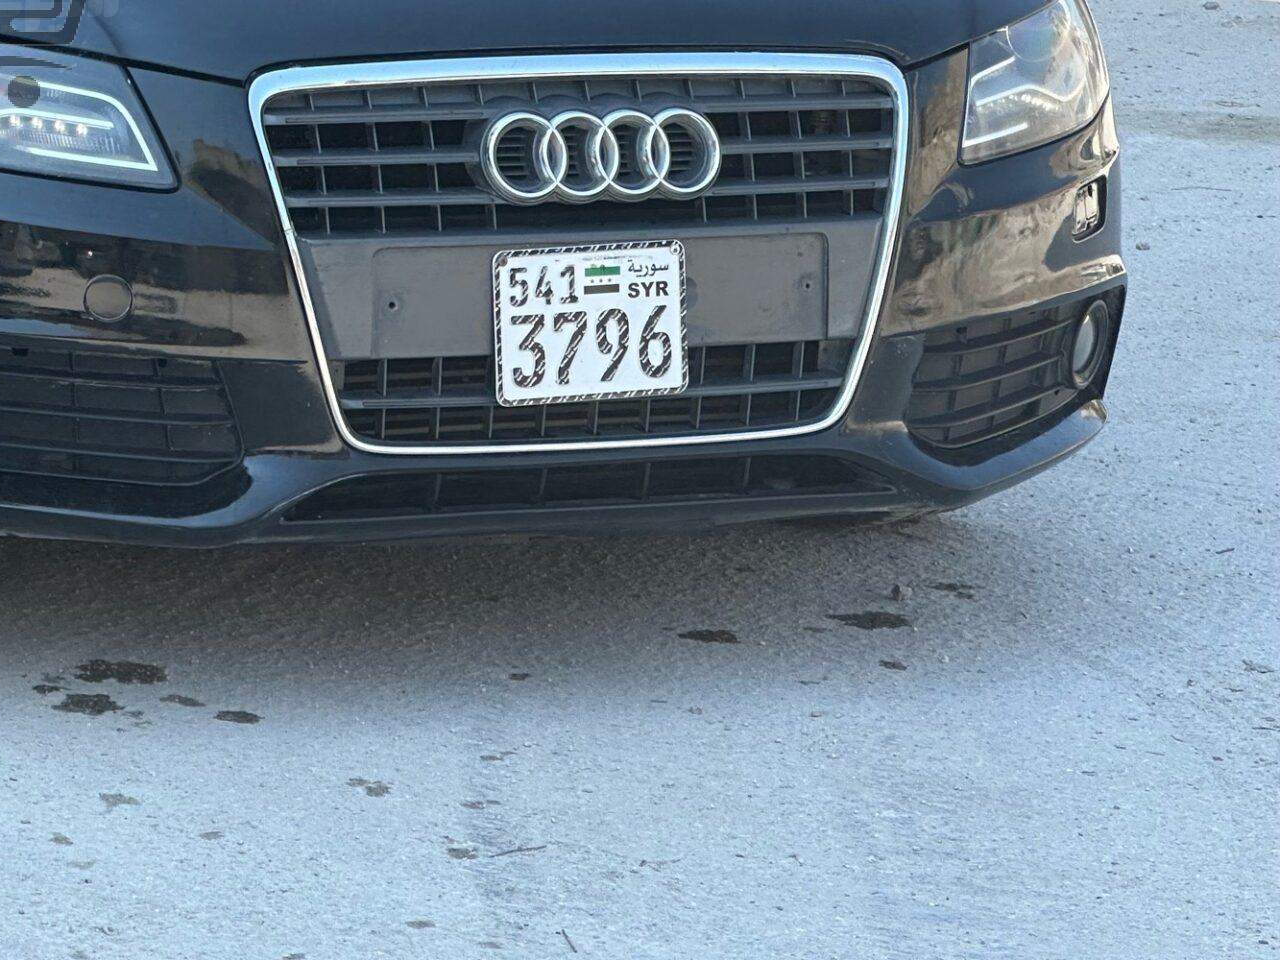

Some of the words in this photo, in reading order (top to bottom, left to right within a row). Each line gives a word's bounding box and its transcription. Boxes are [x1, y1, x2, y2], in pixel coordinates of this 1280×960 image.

[628, 258, 669, 278] سورية
[509, 264, 579, 307] 541
[628, 281, 669, 299] SYR
[510, 305, 672, 388] 3796
